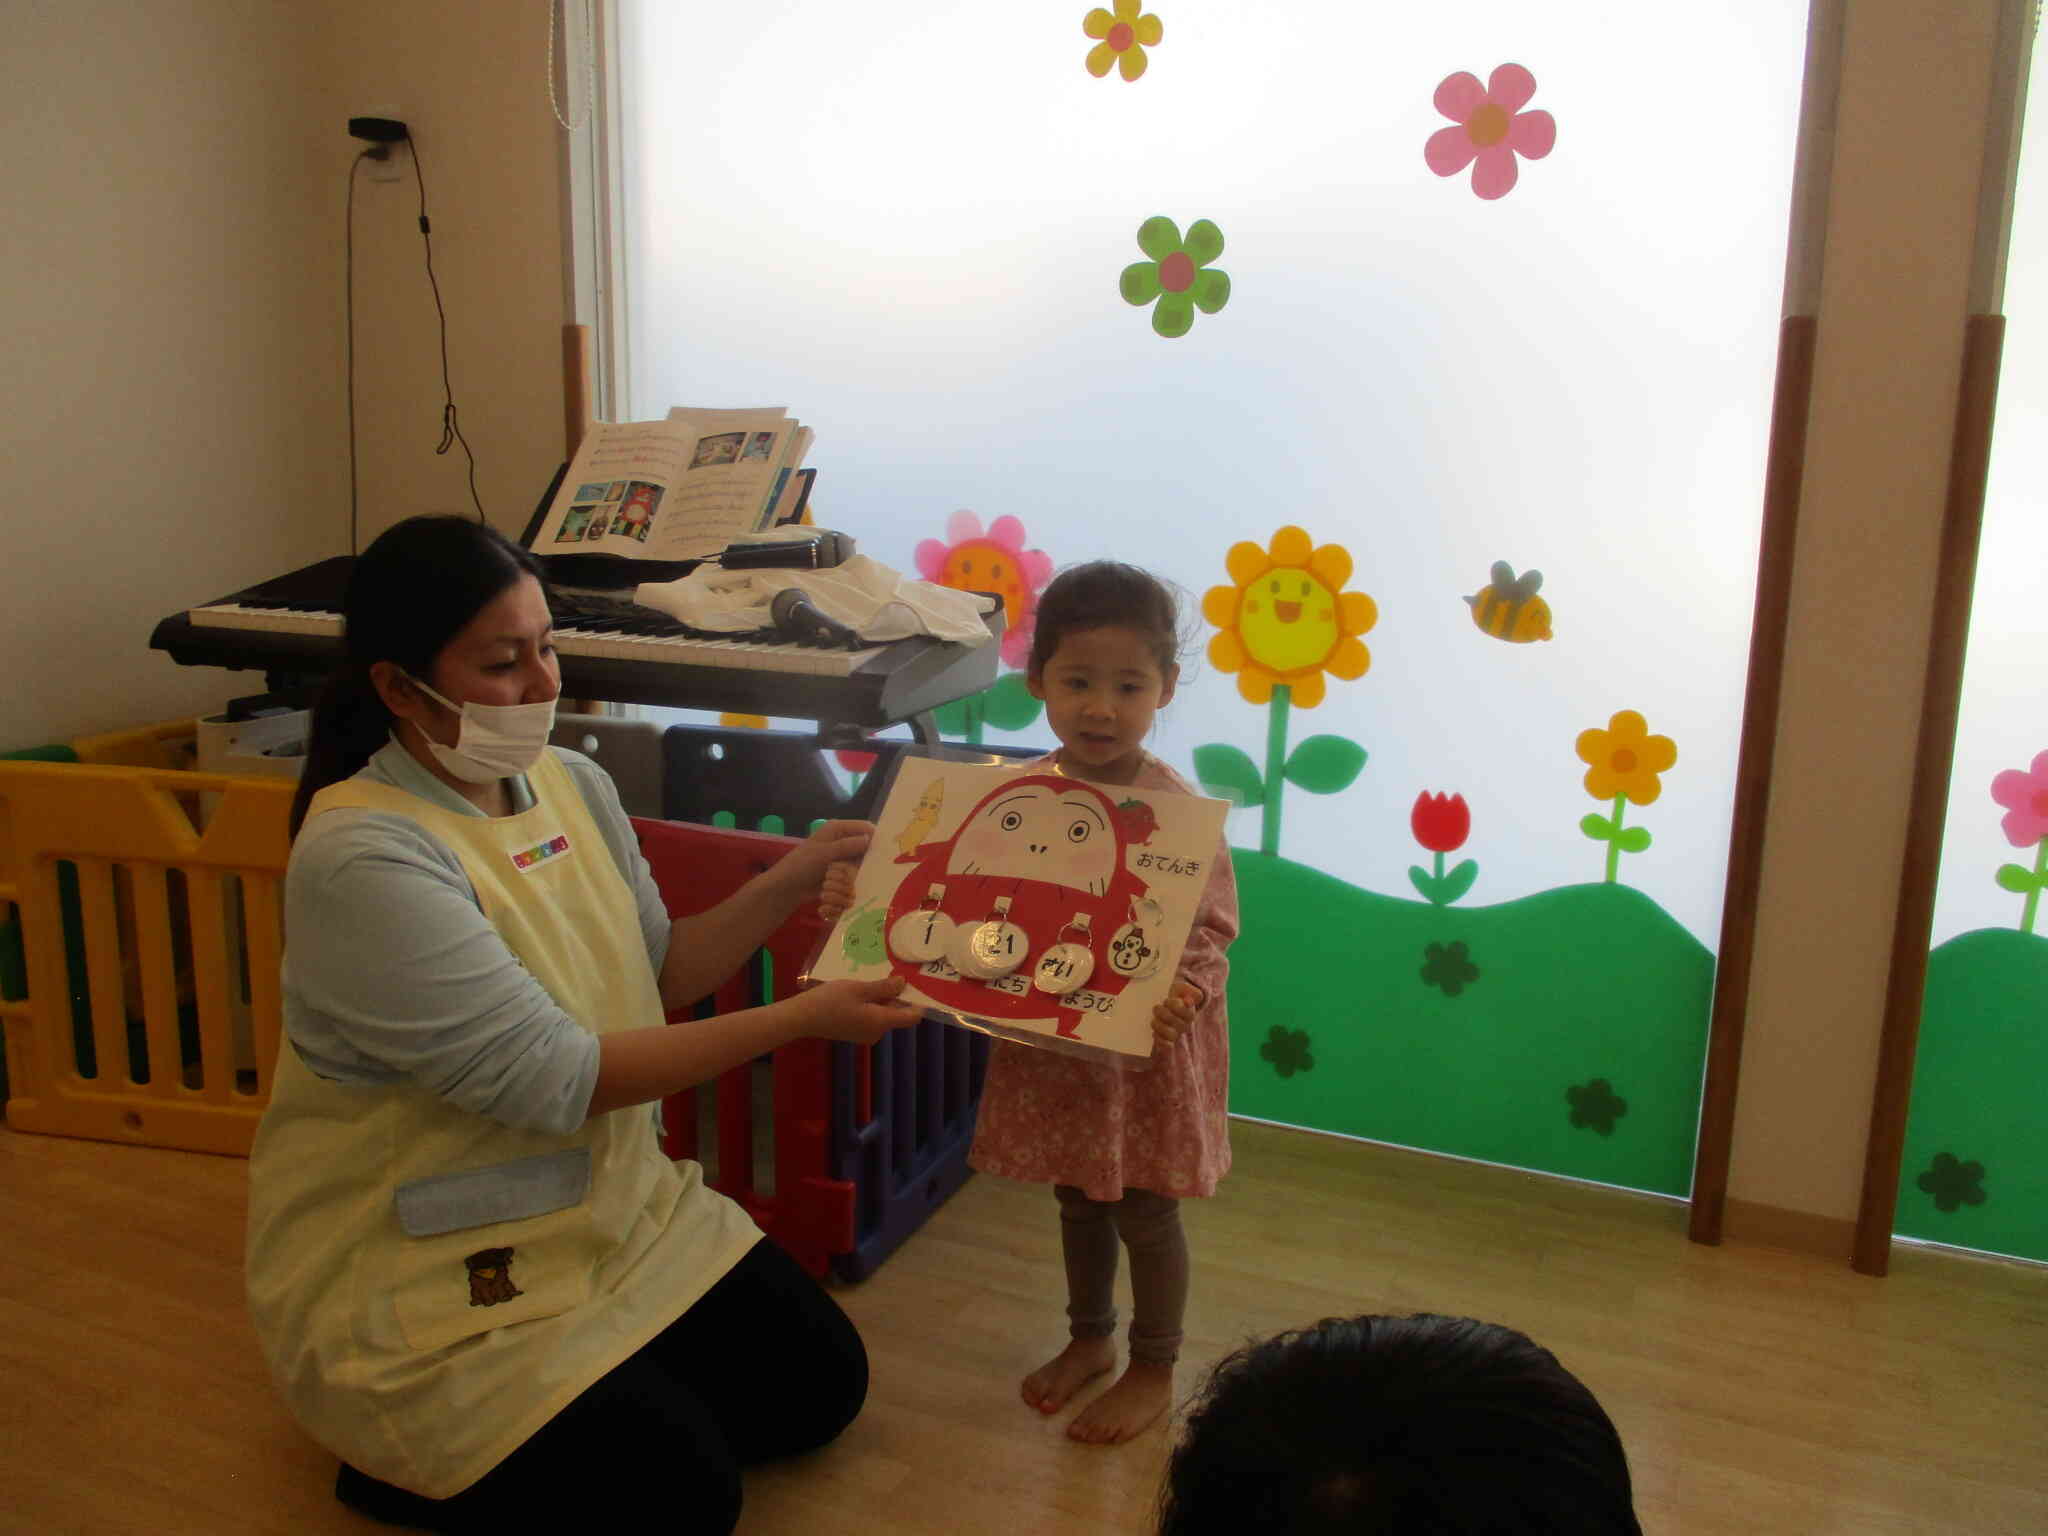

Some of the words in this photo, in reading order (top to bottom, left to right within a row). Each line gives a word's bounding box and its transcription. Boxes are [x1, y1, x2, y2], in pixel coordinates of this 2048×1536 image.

[1136, 853, 1200, 877] おてんき
[924, 923, 934, 945] 1
[992, 976, 1026, 993] にち
[1064, 989, 1113, 1013] ようび
